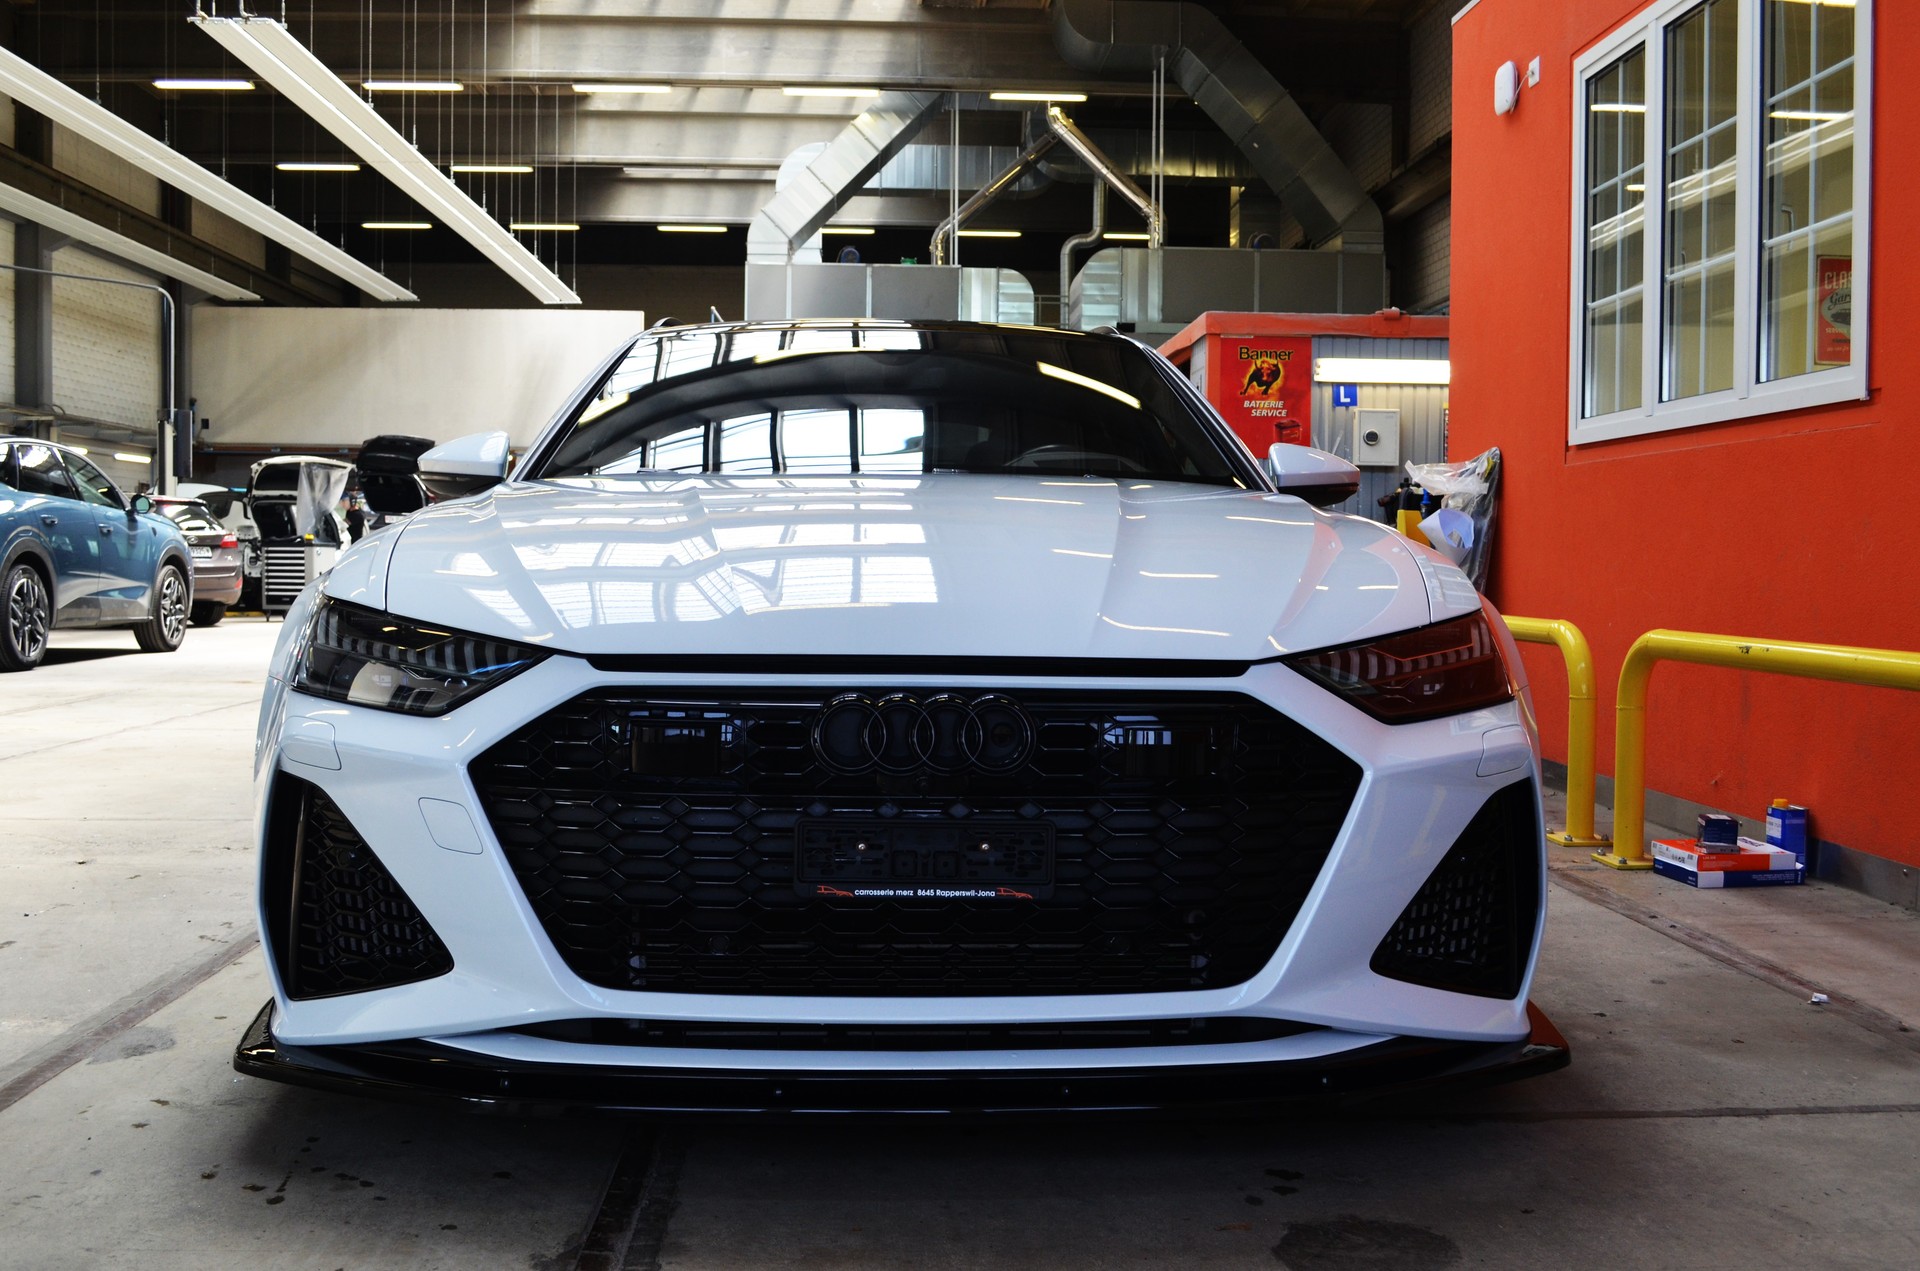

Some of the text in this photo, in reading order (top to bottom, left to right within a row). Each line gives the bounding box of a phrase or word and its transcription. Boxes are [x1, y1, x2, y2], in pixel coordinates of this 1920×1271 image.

[1239, 346, 1293, 360] Banner
[1340, 385, 1351, 403] L
[1243, 400, 1284, 409] BATTERIE
[1251, 409, 1287, 417] SERVICE
[936, 889, 996, 898] Rapperswil-Jona
